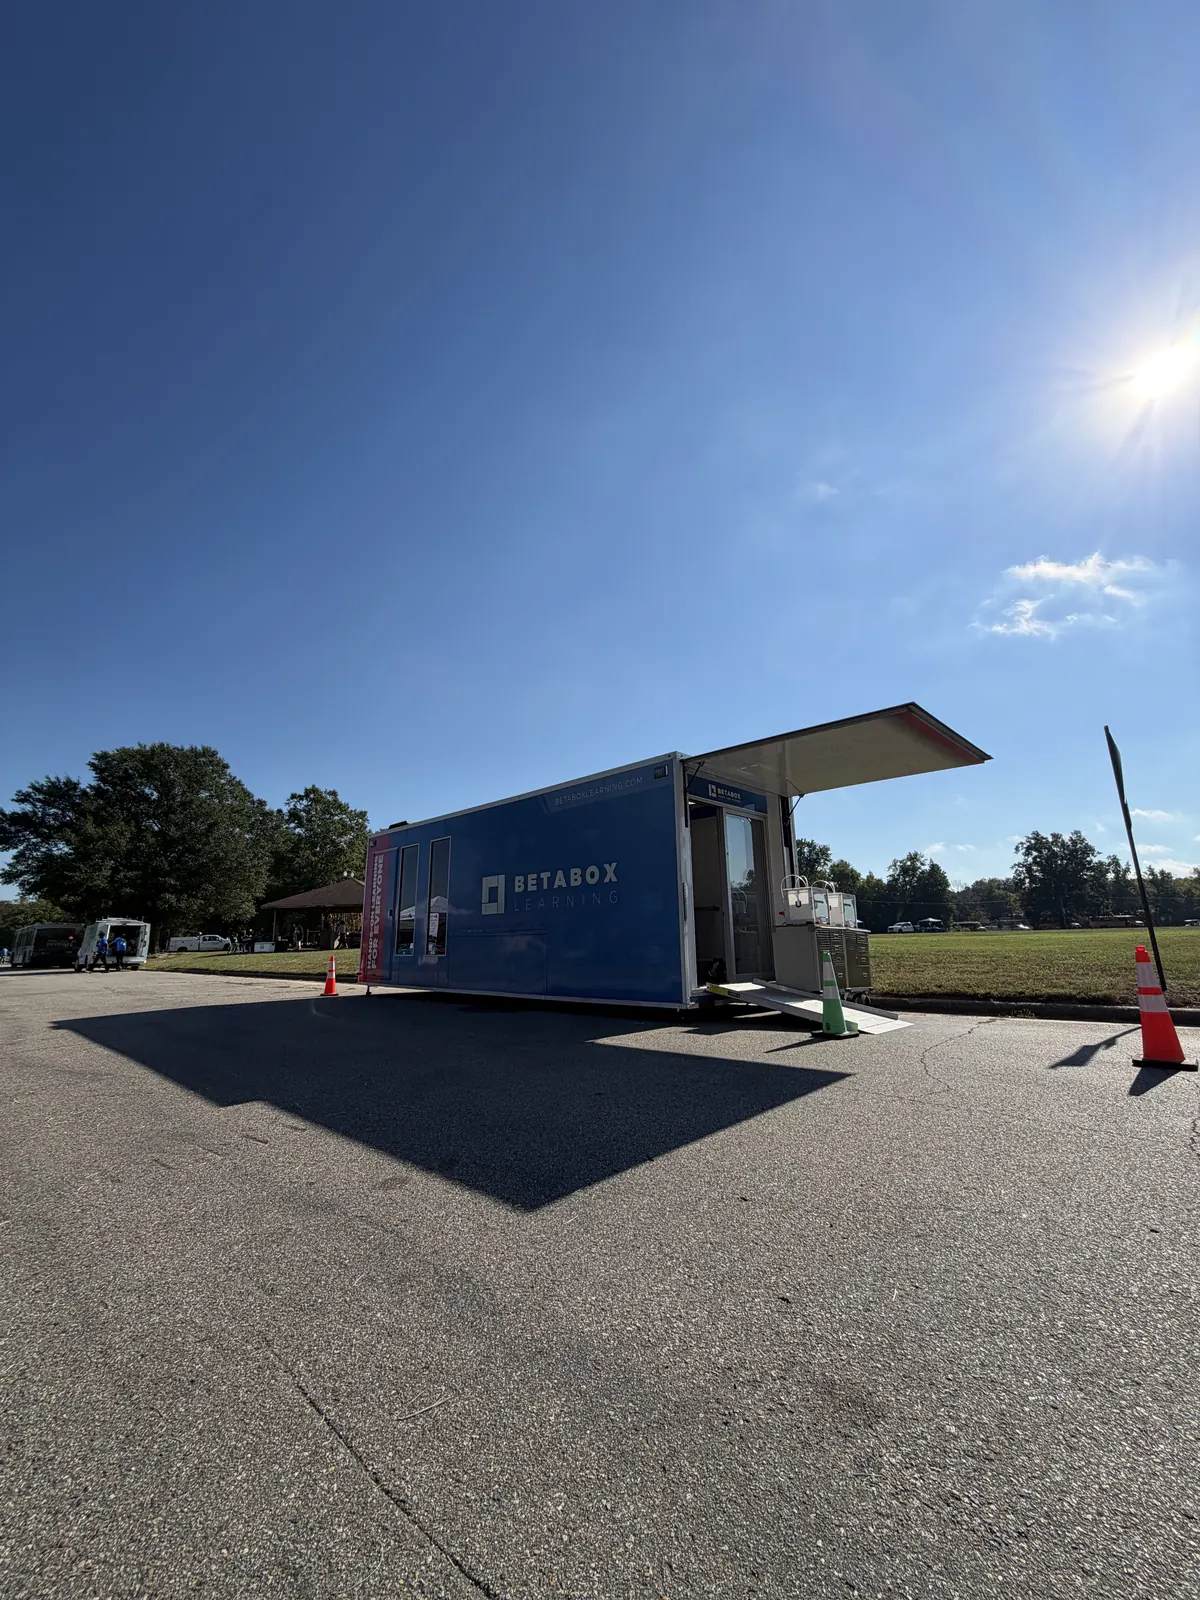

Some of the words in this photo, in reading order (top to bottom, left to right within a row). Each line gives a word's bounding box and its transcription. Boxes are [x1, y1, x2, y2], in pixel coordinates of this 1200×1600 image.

[555, 776, 643, 805] BETABOXLEARNING.COM
[514, 862, 618, 893] BETABOX
[374, 854, 384, 934] EVERYONE
[513, 890, 619, 912] LEARNING
[367, 911, 375, 969] HANDS-ON
[371, 855, 379, 909] LEARNING
[371, 938, 379, 969] FOR
